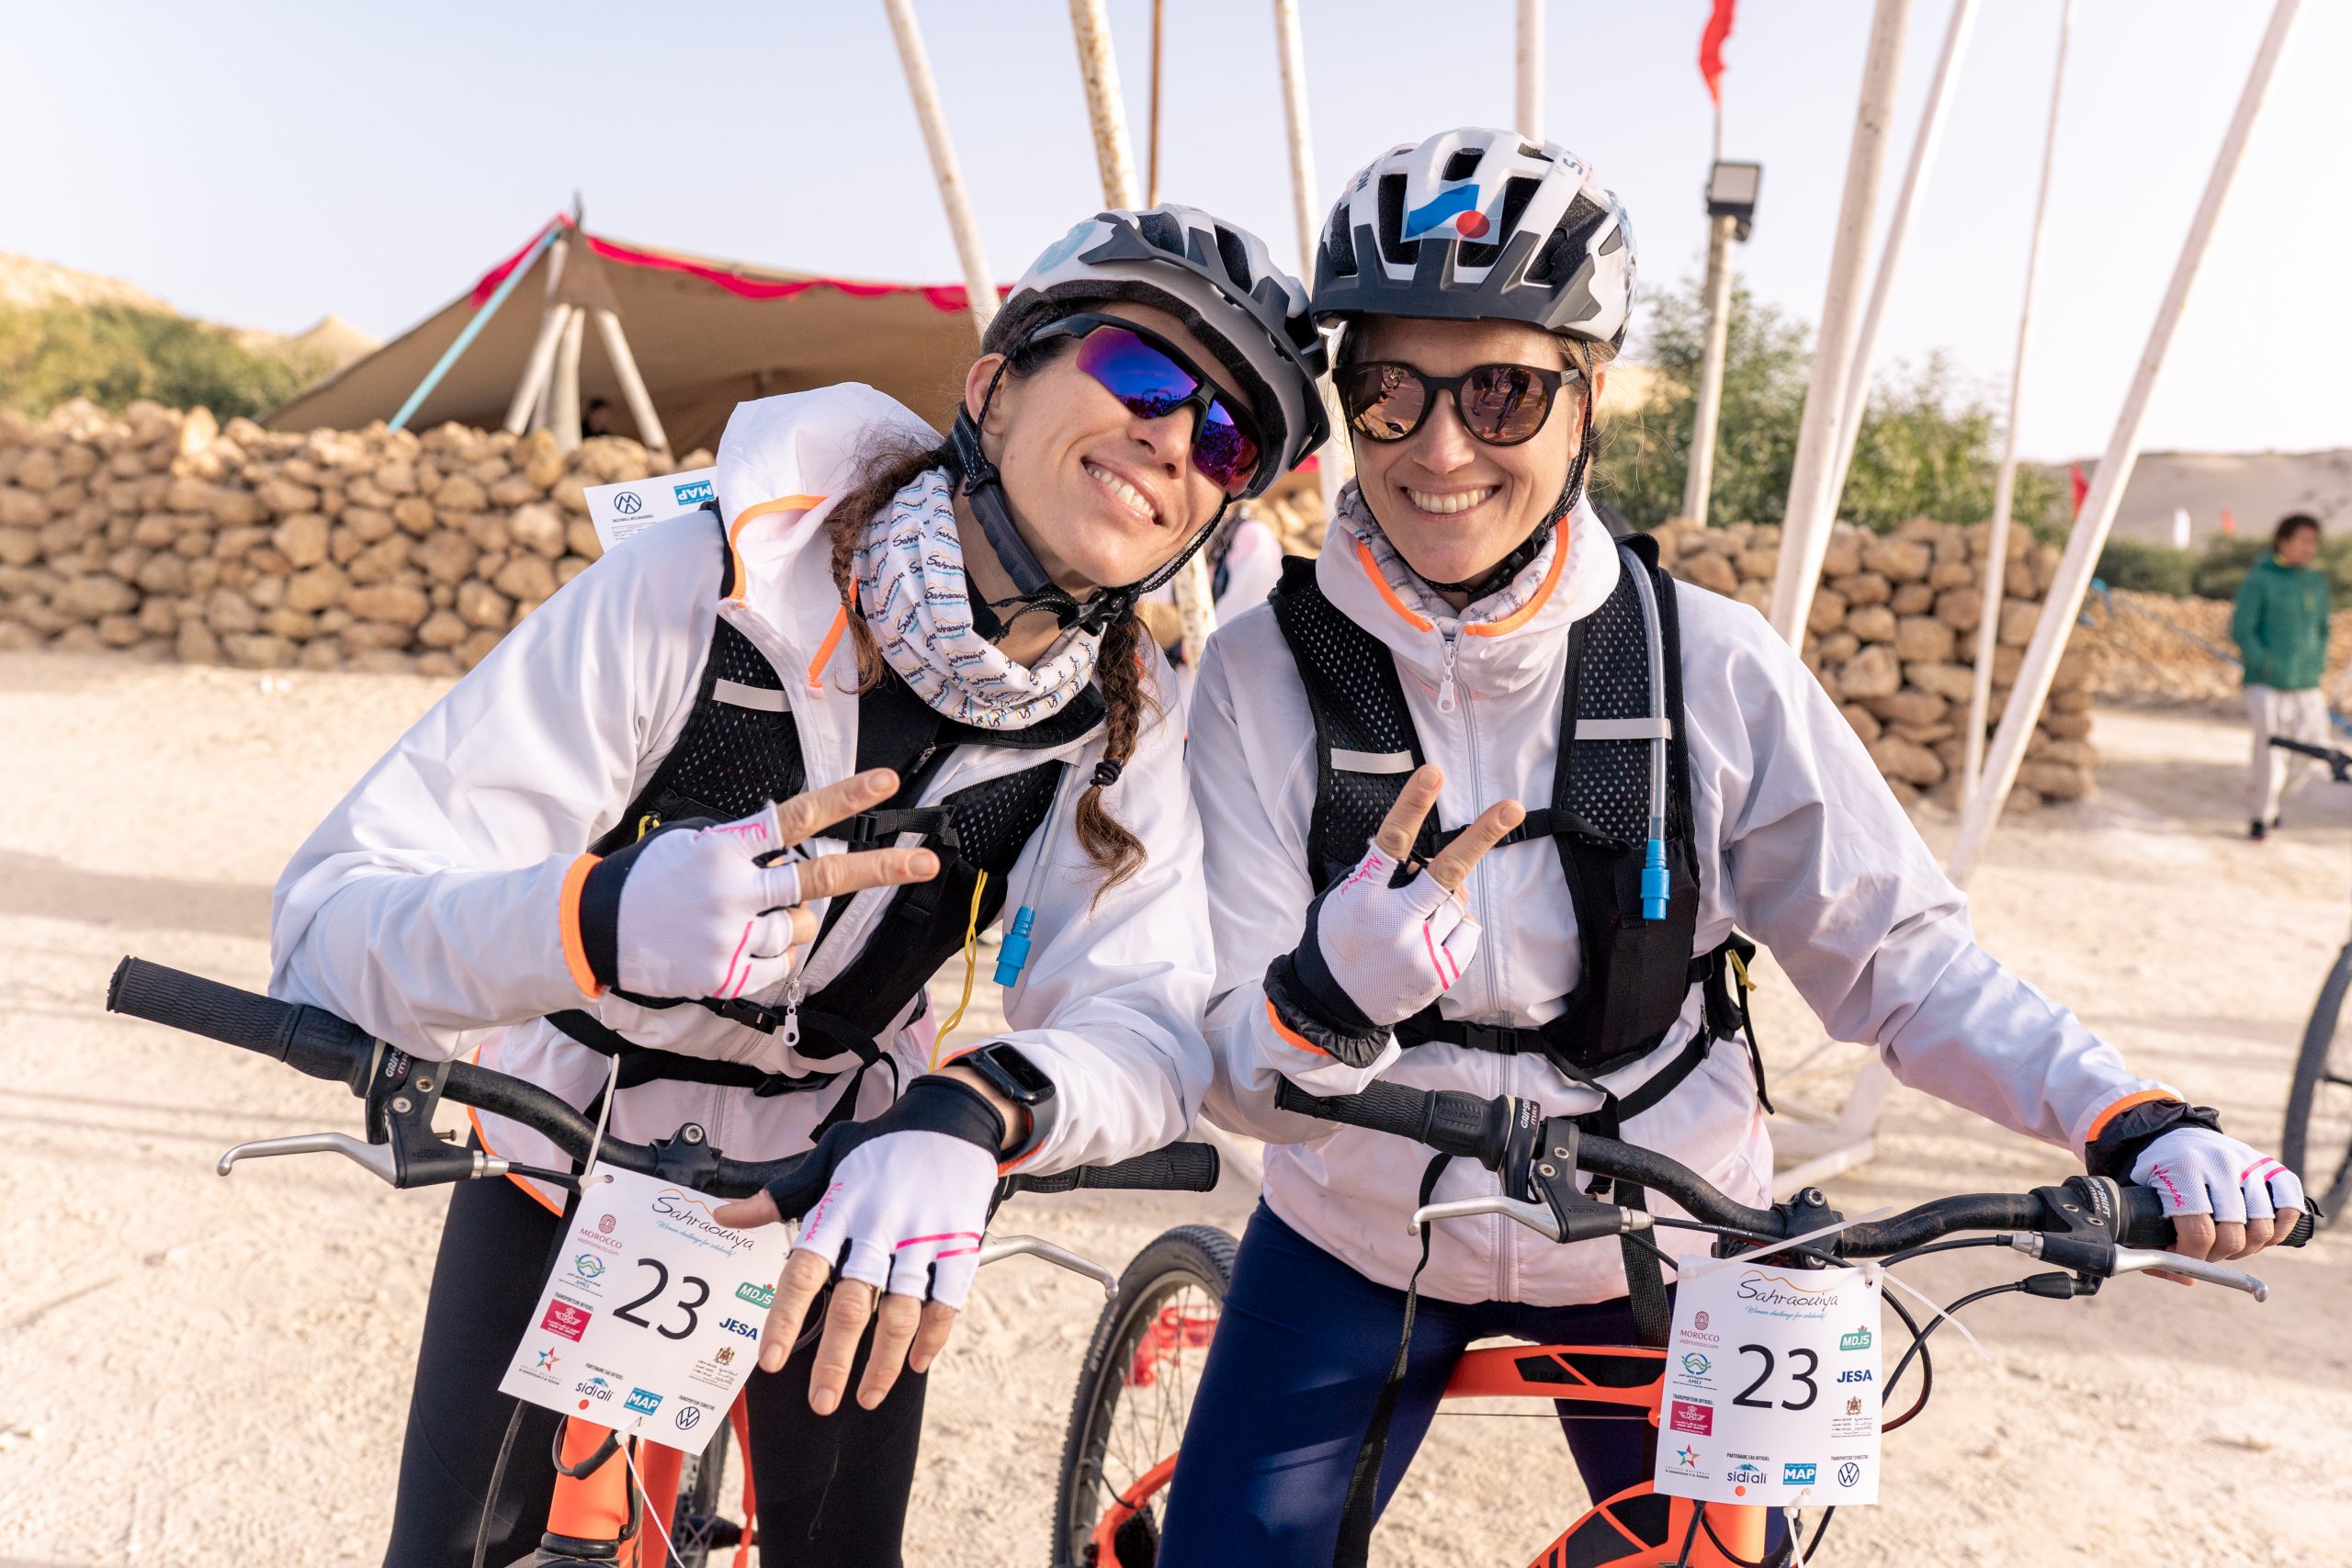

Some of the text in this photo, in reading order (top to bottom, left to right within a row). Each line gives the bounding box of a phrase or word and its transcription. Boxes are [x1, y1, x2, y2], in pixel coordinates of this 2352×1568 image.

[651, 1196, 755, 1251] Sahraouiya
[580, 1228, 623, 1249] MOROCCO
[612, 1258, 710, 1340] 23
[740, 1285, 775, 1305] MDJS
[1736, 1278, 1839, 1312] Sahraouiya
[719, 1317, 758, 1341] JESA
[1679, 1329, 1720, 1343] MOROCCO
[1842, 1335, 1870, 1348] MDJS
[1732, 1344, 1819, 1411] 23
[1837, 1369, 1873, 1383] JESA
[628, 1392, 660, 1411] MAP
[1783, 1469, 1815, 1480] MAP
